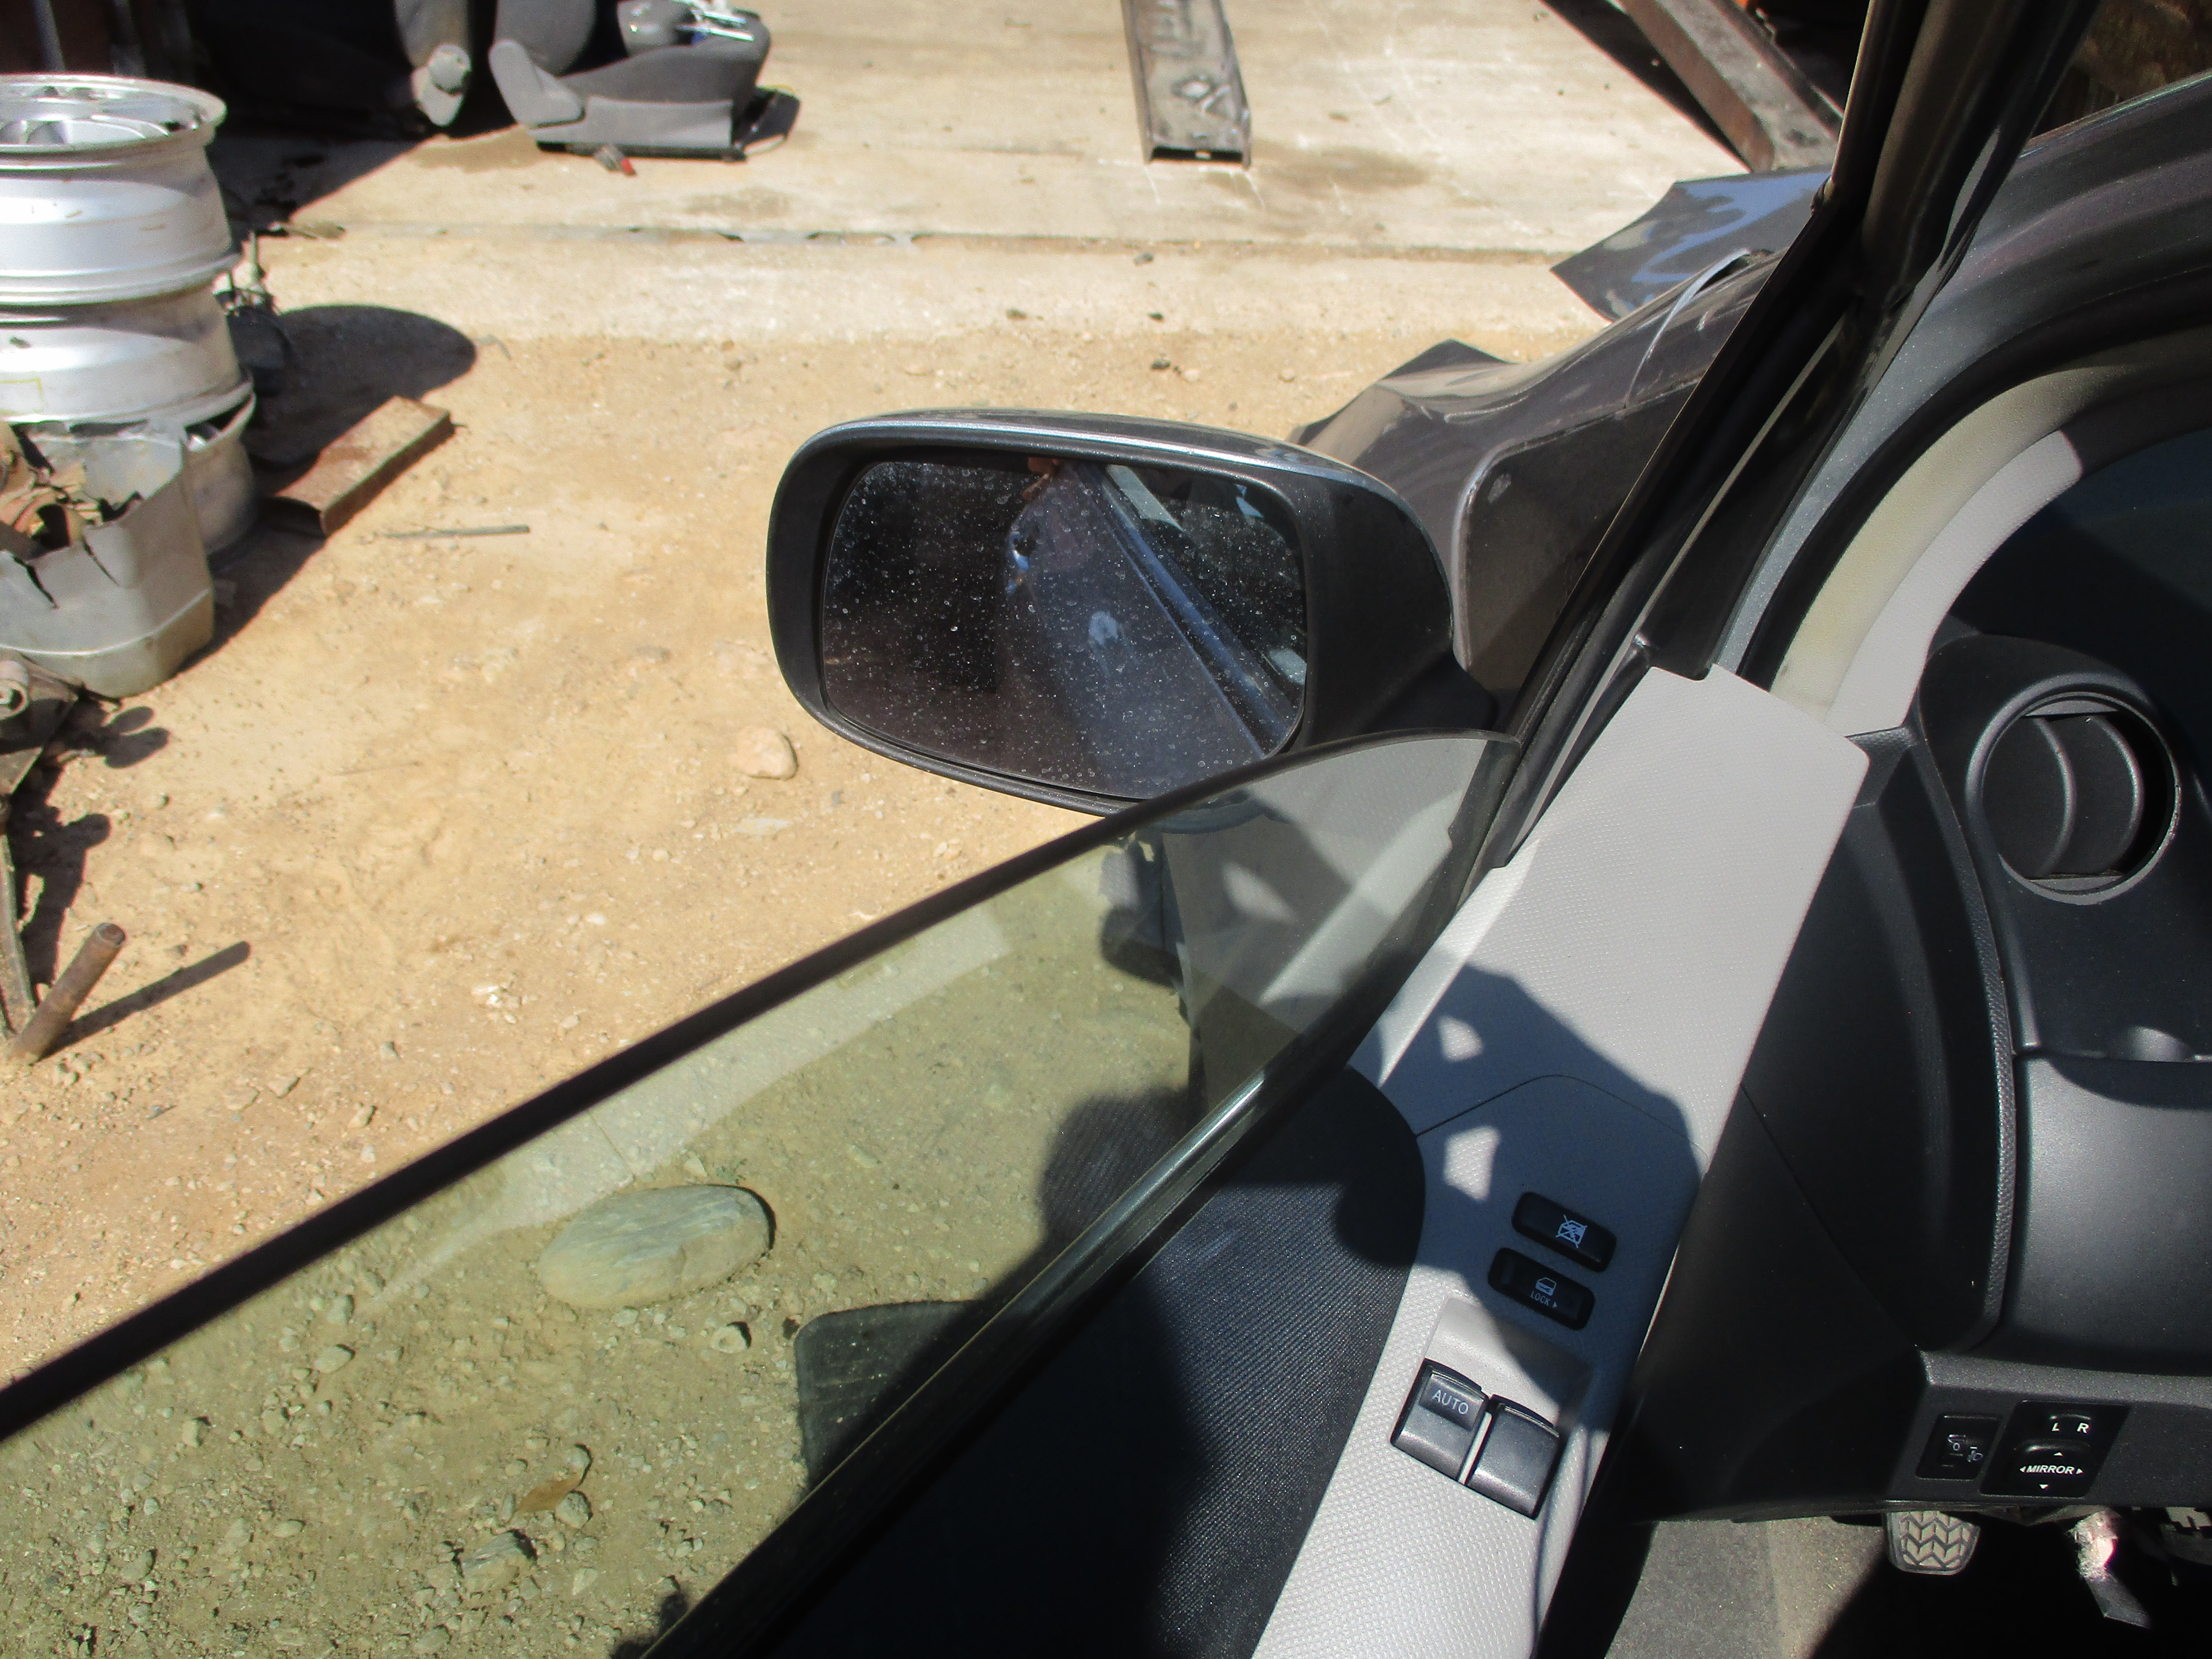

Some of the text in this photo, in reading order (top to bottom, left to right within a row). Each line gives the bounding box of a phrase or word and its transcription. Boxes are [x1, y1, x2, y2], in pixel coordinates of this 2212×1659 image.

[1530, 1290, 1550, 1306] LOCK
[1431, 1389, 1469, 1414] AUTO
[2051, 1422, 2089, 1434] L R
[2026, 1465, 2075, 1475] MIRROR
